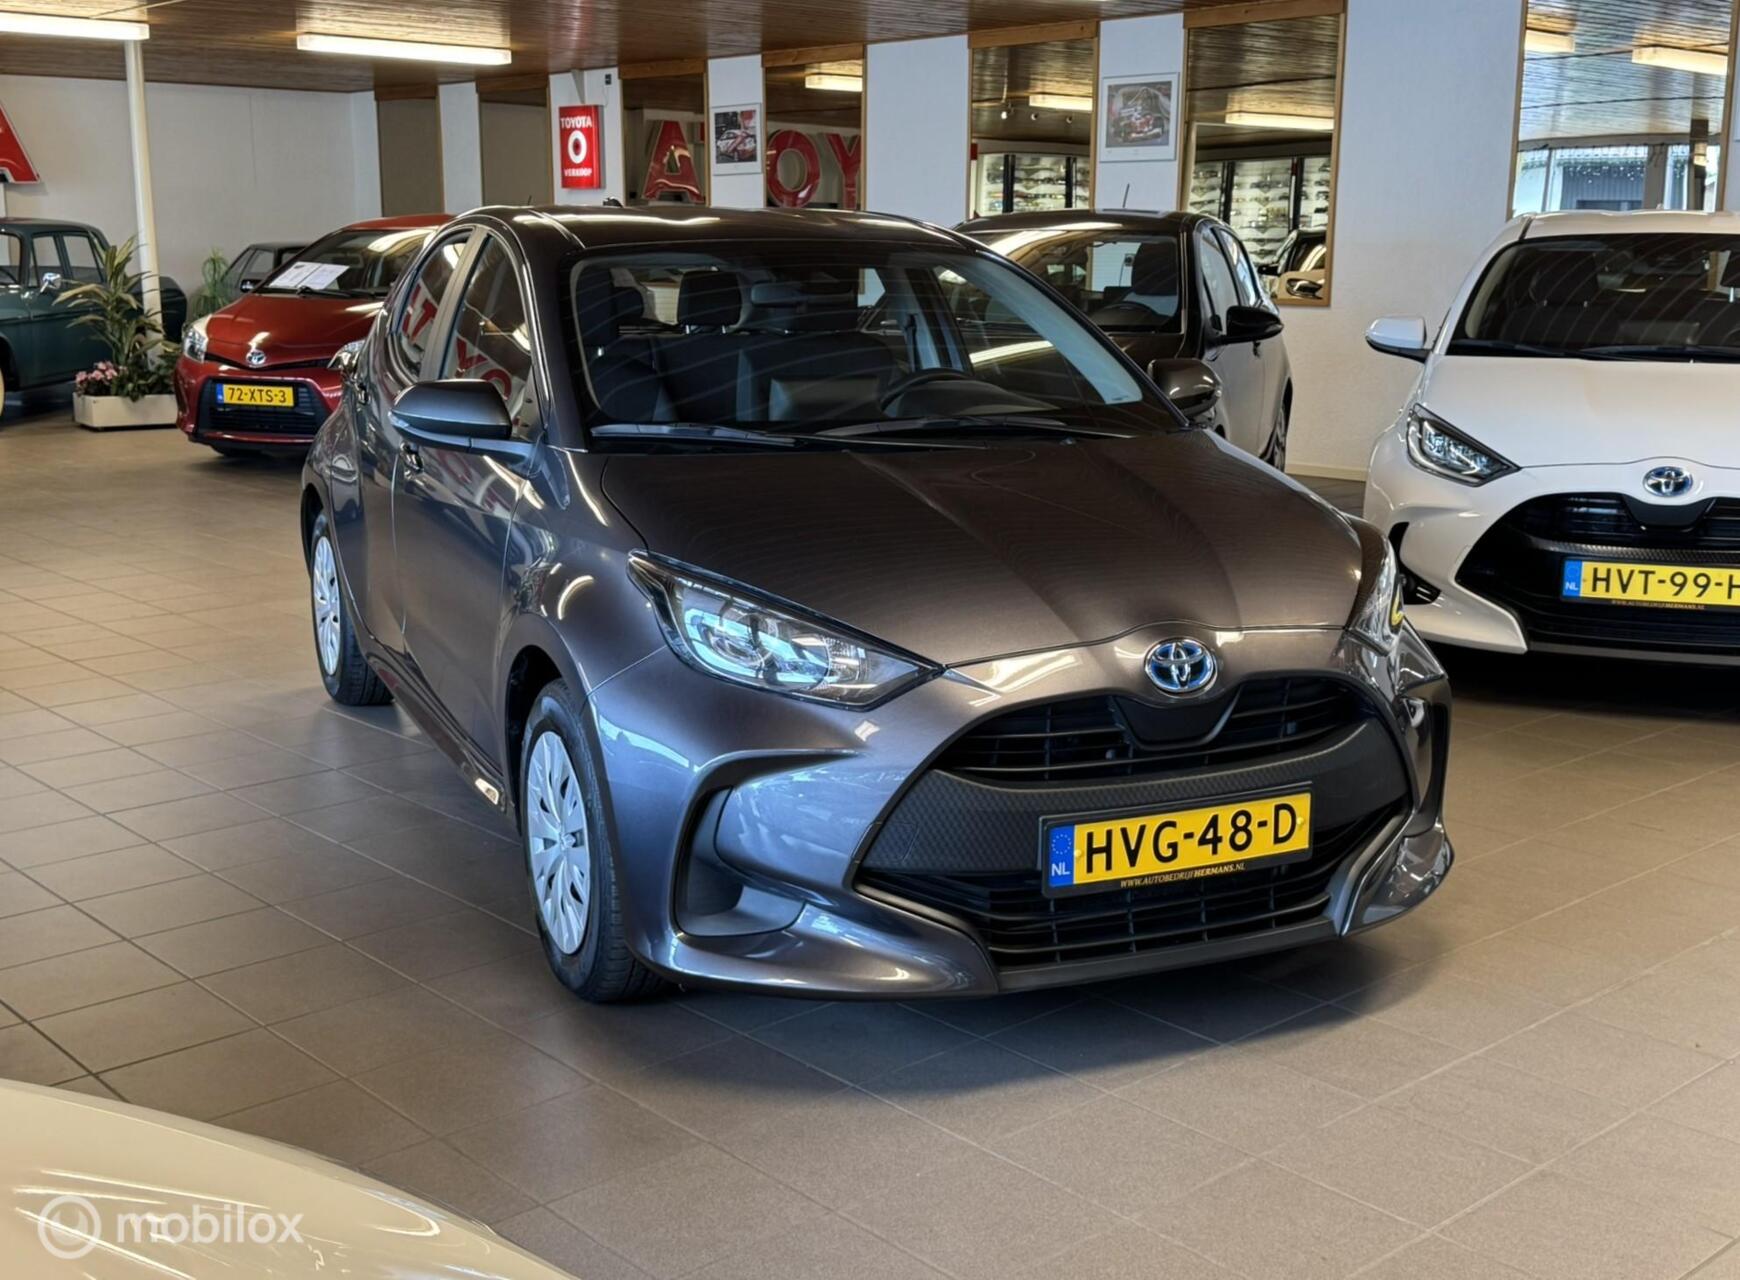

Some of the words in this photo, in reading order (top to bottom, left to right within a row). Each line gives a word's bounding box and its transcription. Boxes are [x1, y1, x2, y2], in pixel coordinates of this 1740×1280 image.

[561, 115, 593, 129] TOYOTA
[227, 387, 287, 404] 72-XTS-3
[1565, 582, 1579, 591] NL
[1592, 567, 1740, 600] HVT-99-H
[1051, 862, 1070, 876] NL
[1086, 803, 1298, 874] HVG-48-D
